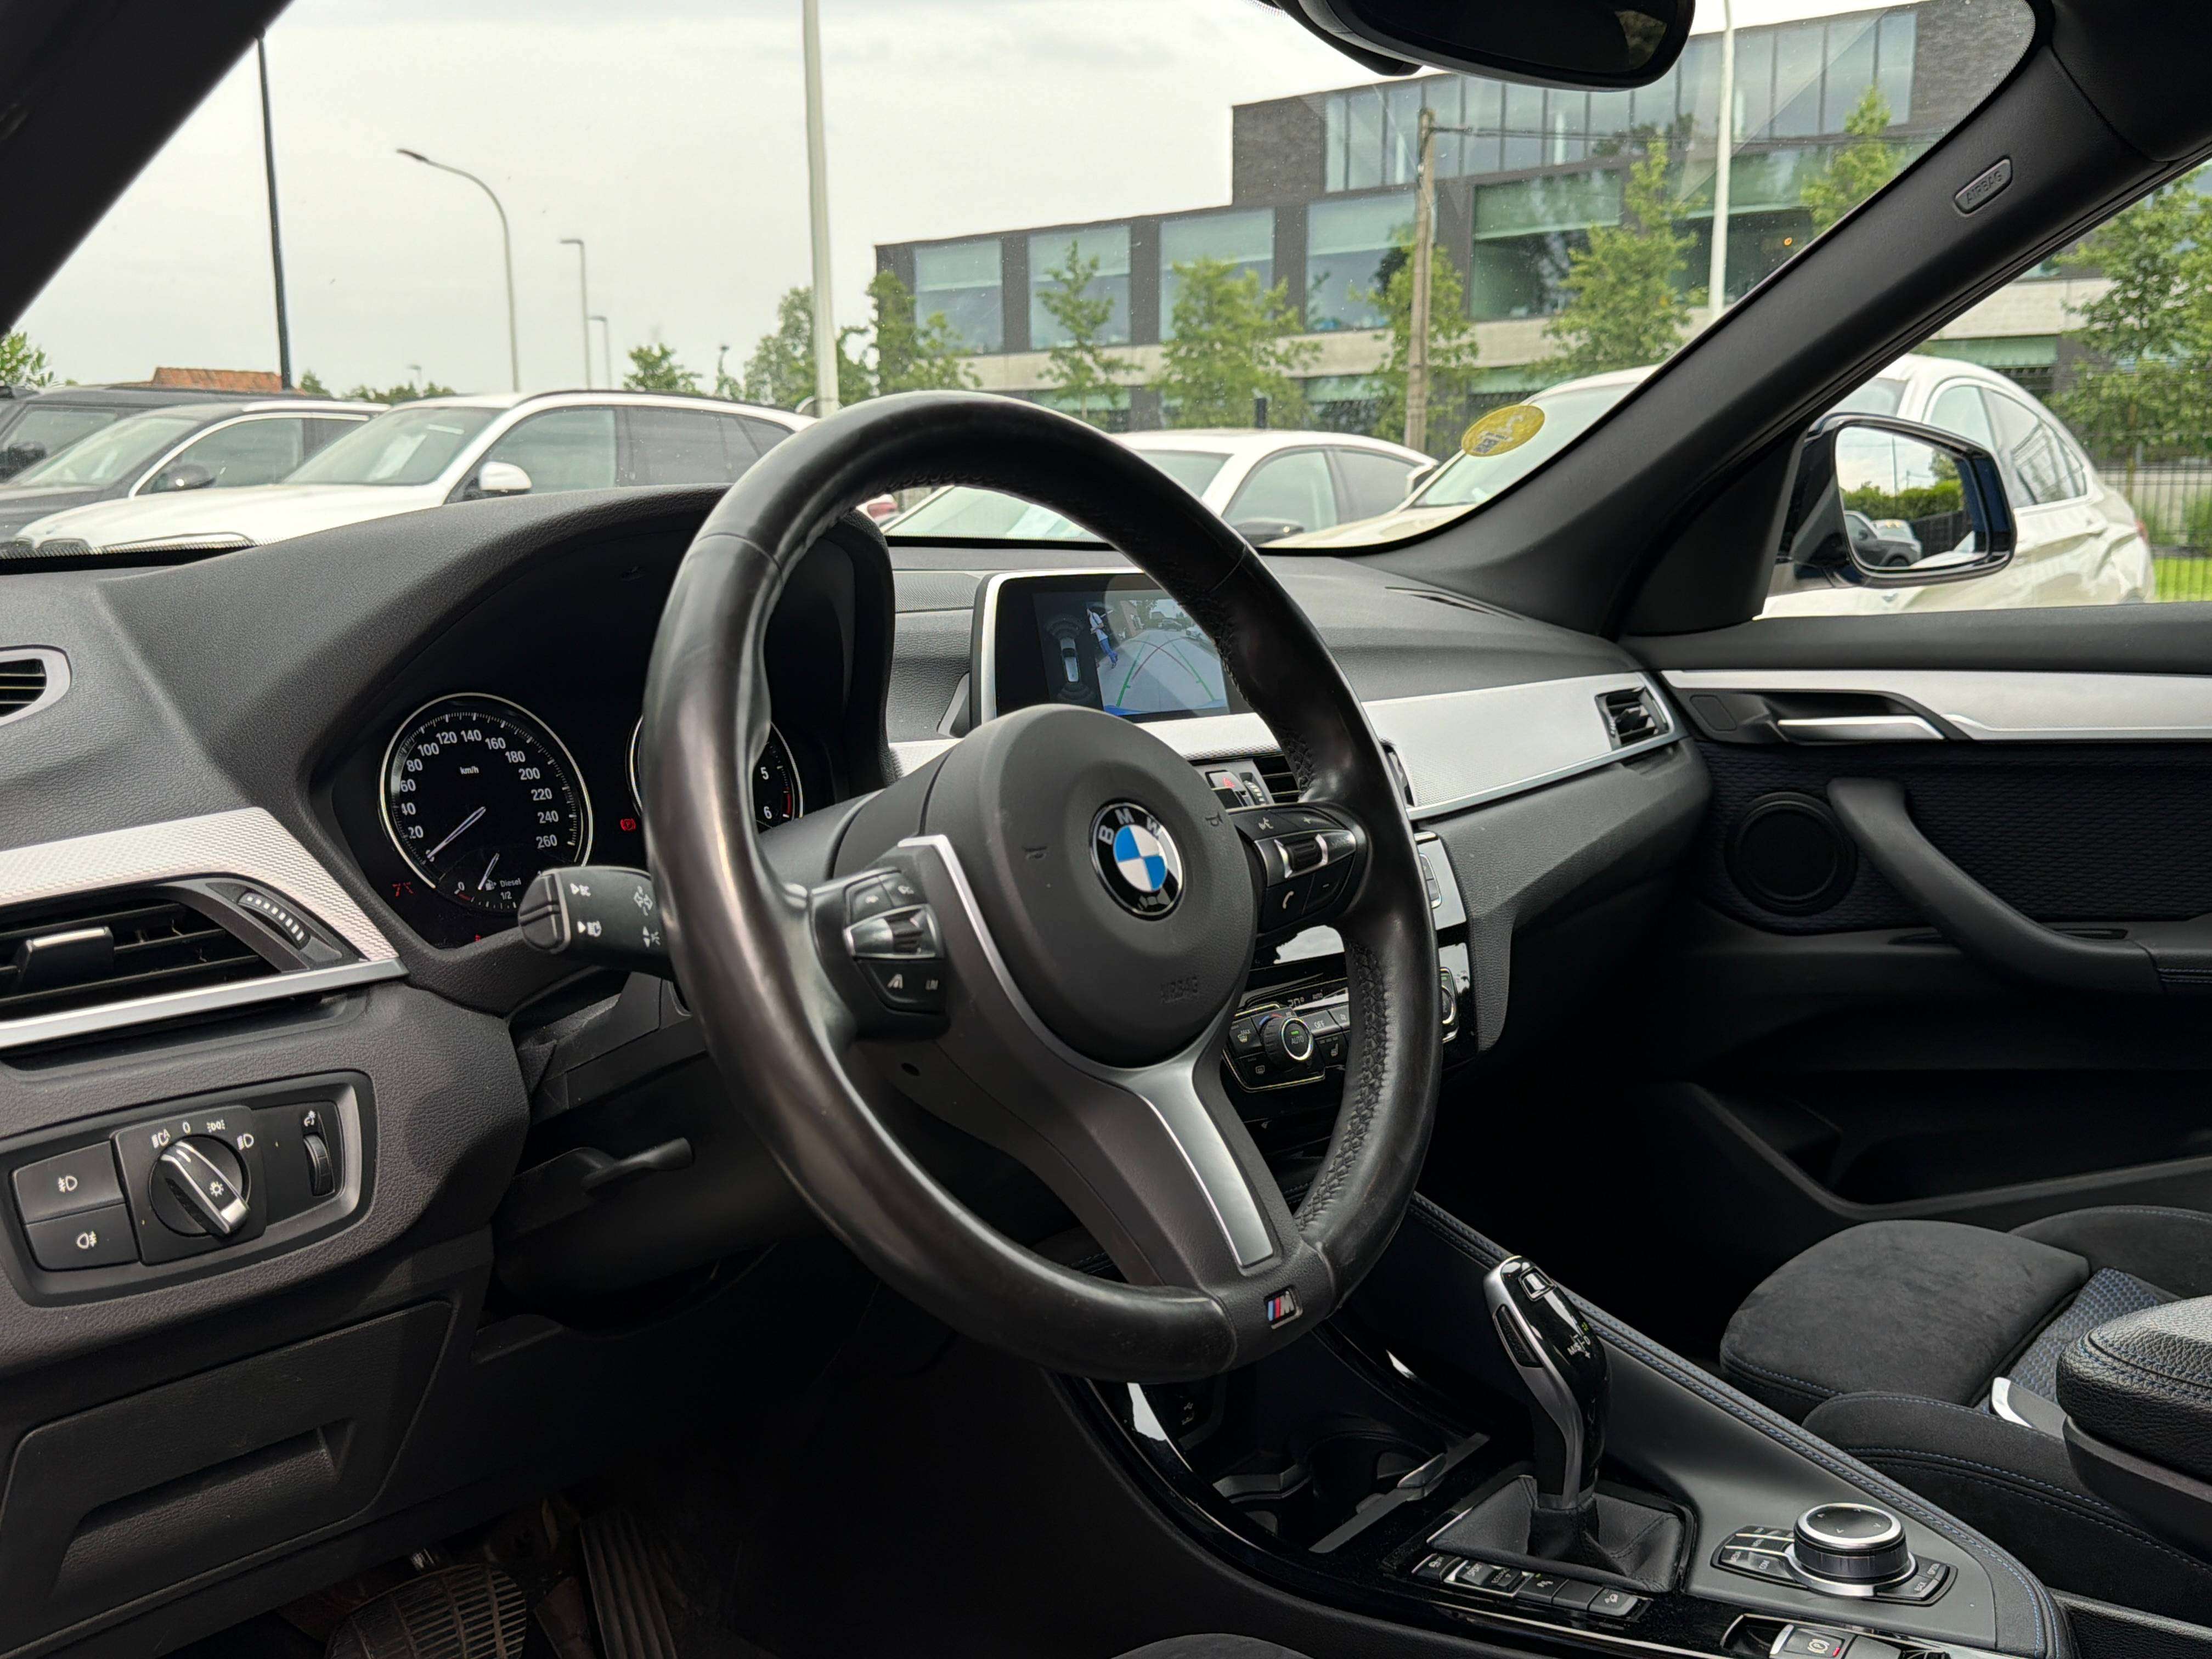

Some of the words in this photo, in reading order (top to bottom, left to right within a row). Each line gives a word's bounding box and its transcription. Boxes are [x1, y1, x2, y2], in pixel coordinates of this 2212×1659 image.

[436, 731, 458, 744] 120
[460, 729, 482, 742] 140
[417, 742, 439, 757] 100
[485, 737, 506, 750] 160
[505, 751, 526, 763] 180
[406, 758, 423, 772] 80
[459, 766, 479, 775] km/h
[518, 767, 540, 780] 200
[760, 767, 769, 780] 5
[400, 779, 416, 792] 60
[531, 788, 552, 801] 220
[401, 802, 416, 816] 40
[763, 806, 772, 819] 6
[537, 810, 558, 823] 240
[408, 826, 424, 839] 20
[1098, 808, 1163, 845] BMW
[535, 834, 557, 849] 260
[458, 882, 465, 891] 0
[500, 878, 521, 887] Diesel
[500, 890, 512, 900] 1/2
[1314, 1020, 1325, 1029] OFF
[1291, 1035, 1305, 1045] AUTO
